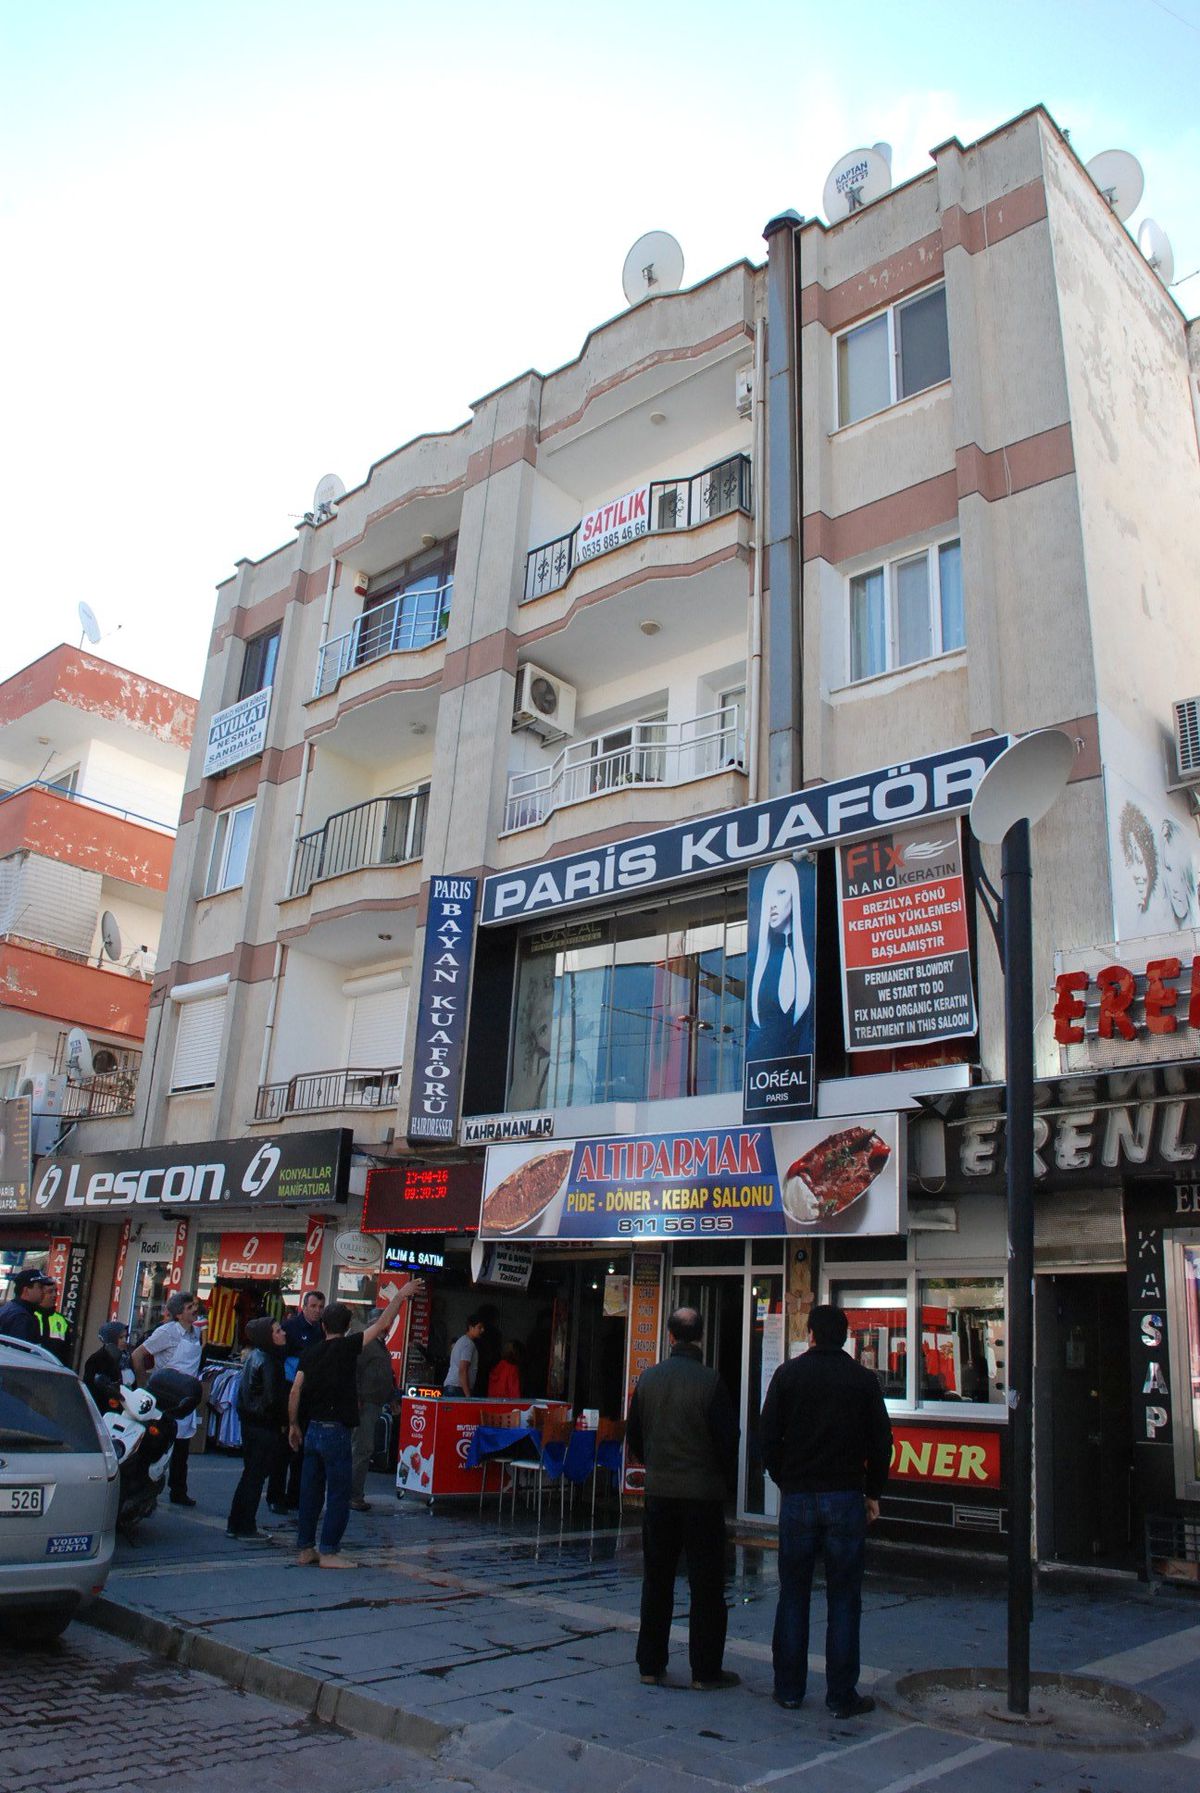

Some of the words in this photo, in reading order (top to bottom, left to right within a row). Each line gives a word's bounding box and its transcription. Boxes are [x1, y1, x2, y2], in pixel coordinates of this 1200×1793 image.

[835, 161, 868, 186] KAPTAN
[583, 489, 647, 541] SATILIK
[582, 539, 601, 559] 0535
[603, 531, 619, 549] 885
[622, 525, 633, 540] 46
[634, 520, 646, 536] 66
[211, 702, 267, 742] AVUKAT
[208, 732, 262, 763] SANDALCI
[494, 844, 658, 919] PARİS
[681, 756, 988, 871] KUAFÖR
[433, 879, 472, 899] PARIS
[849, 876, 896, 896] NANO
[899, 863, 956, 884] KERATIN
[862, 896, 912, 915] BREZİLYA
[914, 886, 946, 905] FÖNÜ
[848, 914, 896, 931] KERATİN
[871, 920, 943, 943] UYGULAMASI
[432, 903, 462, 983] BAYAN
[871, 936, 945, 959] BAŞLAMIŞTIR
[864, 967, 914, 986] PERMANENT
[916, 960, 954, 978] BLOWDRY
[877, 988, 891, 1002] WE
[892, 985, 917, 1001] START
[920, 983, 931, 995] TO
[932, 980, 944, 994] DO
[854, 1009, 869, 1022] FIX
[870, 1006, 894, 1020] NANO
[895, 1000, 933, 1017] ORGANIC
[934, 994, 968, 1012] KERATIN
[855, 1022, 905, 1039] TREATMENT
[906, 1020, 916, 1033] IN
[917, 1018, 936, 1032] THIS
[937, 1012, 969, 1029] SALOON
[422, 994, 458, 1114] KUAFÖRÜ
[765, 1093, 789, 1103] PARIS
[411, 1117, 454, 1138] HAIRDRESSER
[465, 1117, 552, 1141] KAHRAMANLAR
[575, 1132, 763, 1183] ALTIPARMAK
[64, 1163, 226, 1207] Lescon
[279, 1166, 331, 1182] KONYALILAR
[277, 1180, 331, 1198] MANİFATURA
[566, 1187, 596, 1213] PİDE
[605, 1185, 650, 1211] DÖNER
[661, 1186, 709, 1210] KEBAP
[712, 1184, 774, 1208] SALONU
[617, 1218, 657, 1233] 811
[664, 1217, 696, 1232] 56
[700, 1216, 733, 1231] 95
[141, 1241, 161, 1254] Rodi
[386, 1247, 408, 1262] ALIM
[408, 1250, 416, 1263] &
[417, 1252, 444, 1267] SATIM
[221, 1258, 278, 1275] Lescon
[499, 1272, 522, 1283] Tailor
[1138, 1230, 1169, 1439] KASAP
[890, 1440, 989, 1480] NER
[11, 1491, 39, 1509] 526
[50, 1544, 88, 1553] PENTA
[52, 1536, 88, 1546] VOLVO
